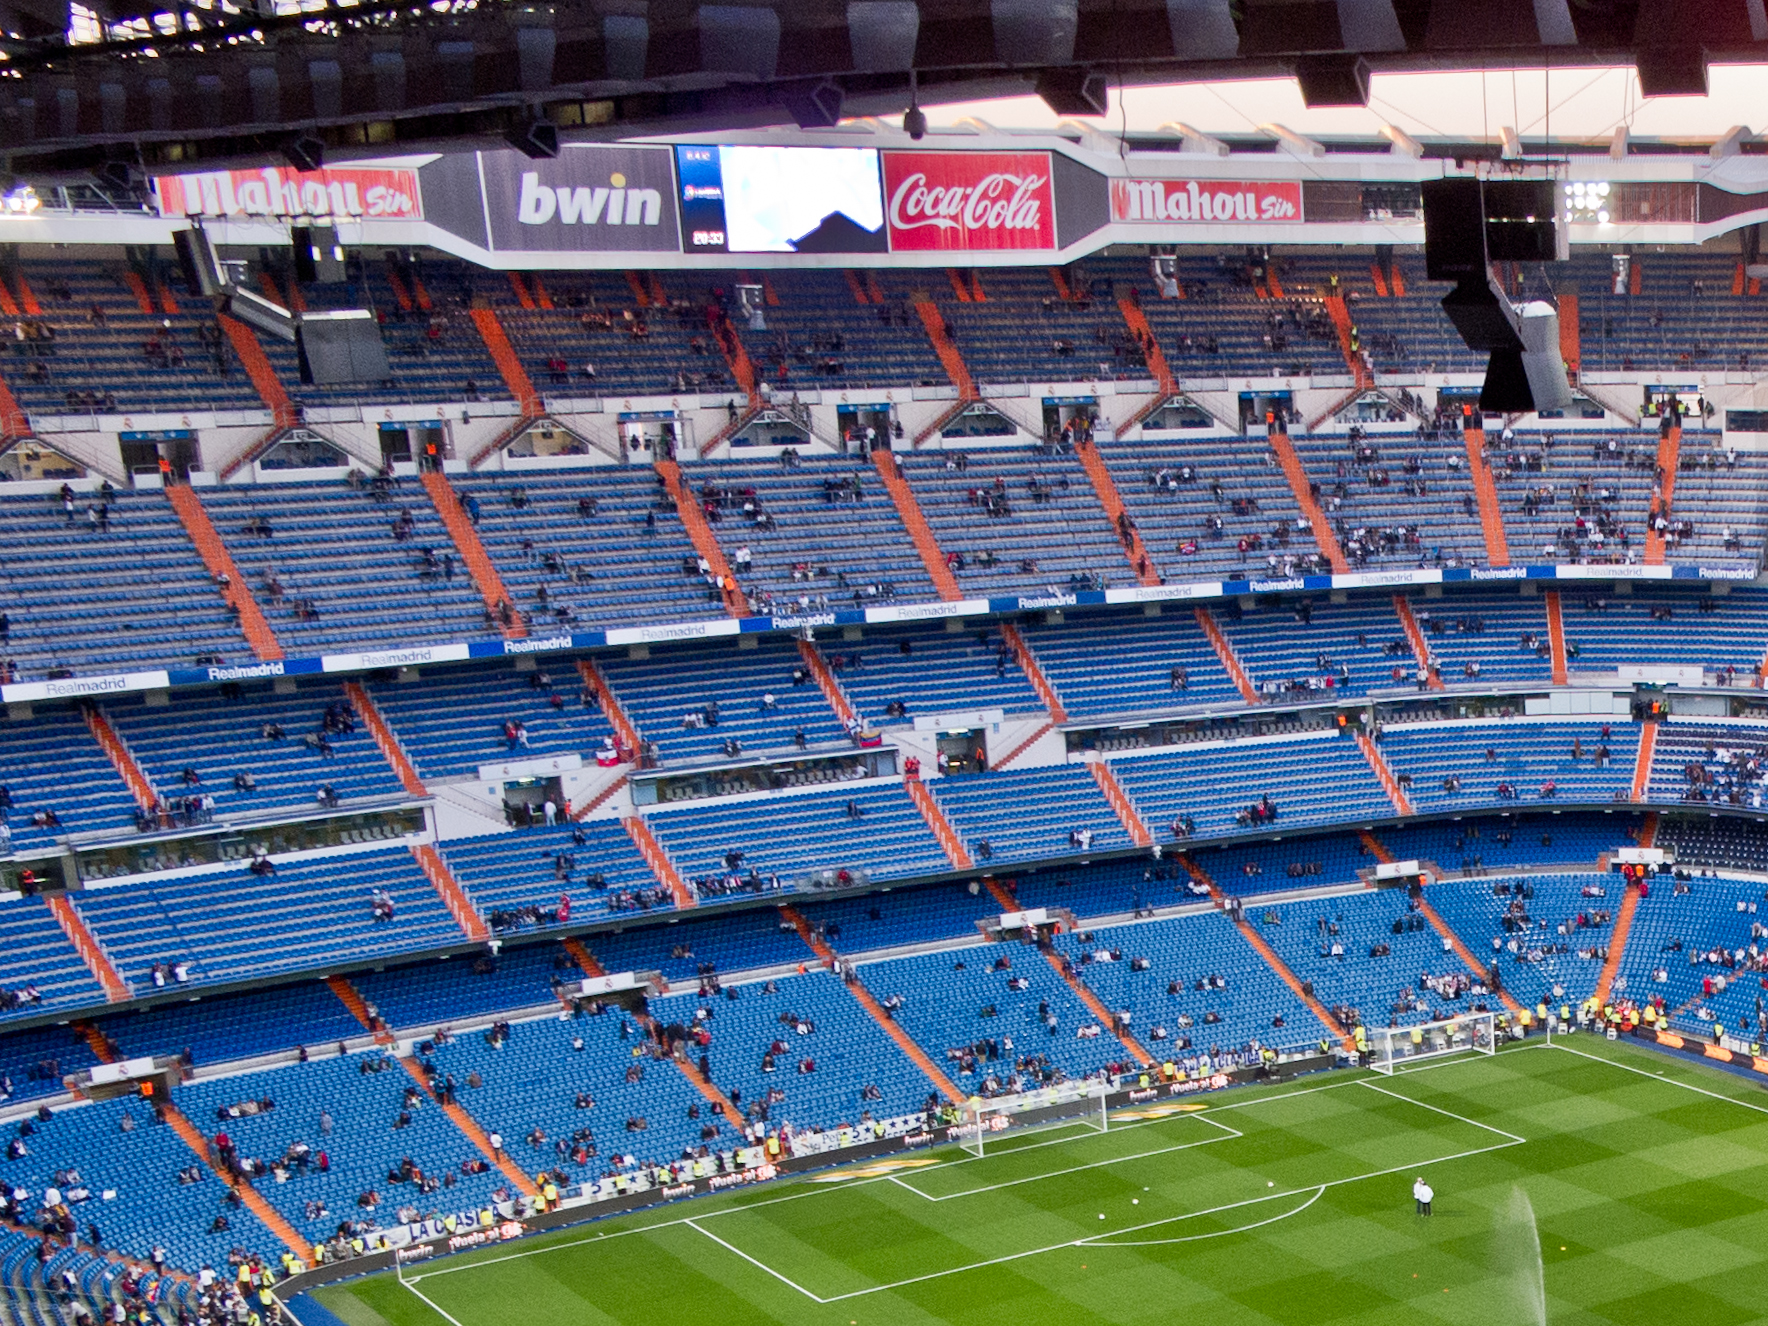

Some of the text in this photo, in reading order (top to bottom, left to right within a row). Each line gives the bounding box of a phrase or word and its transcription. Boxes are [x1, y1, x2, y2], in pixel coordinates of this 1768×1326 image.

[365, 186, 412, 216] Sin
[518, 171, 661, 225] bwin
[890, 173, 1047, 230] Coca-Cola
[1128, 181, 1295, 220] Mahou Sin
[1586, 567, 1643, 577] Realmadrid
[1699, 567, 1756, 580] Realmadrid
[1250, 578, 1304, 593] Realmadrid
[504, 636, 572, 654] Realmadrid
[207, 661, 285, 681] Realmadrid
[46, 677, 126, 697] Realmadrid
[408, 1222, 430, 1241] LA
